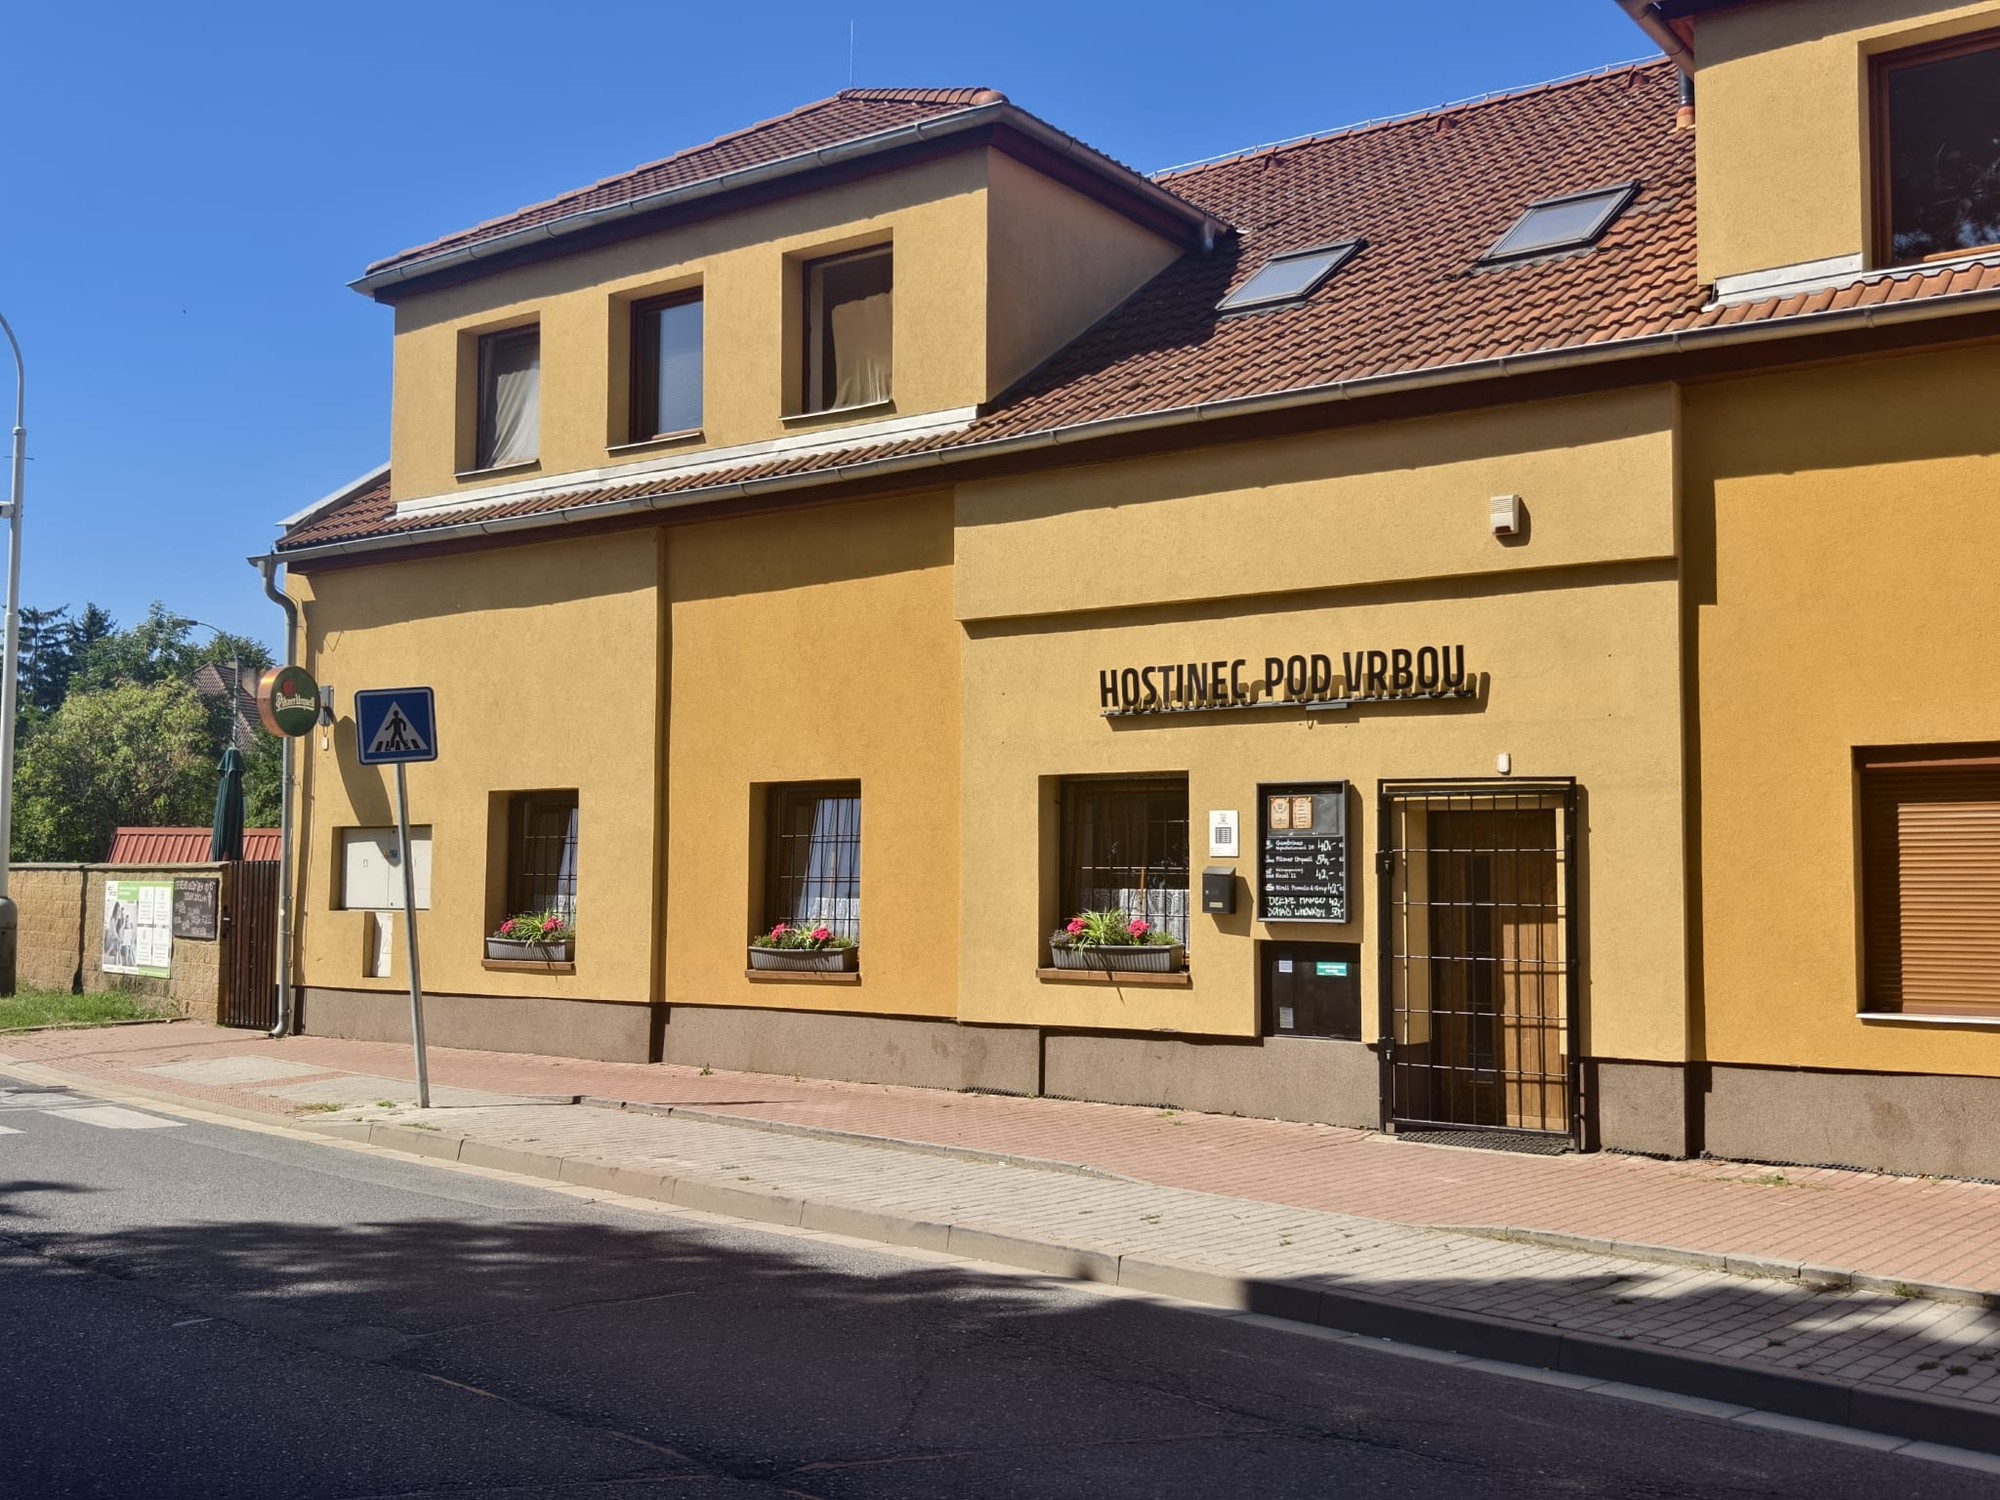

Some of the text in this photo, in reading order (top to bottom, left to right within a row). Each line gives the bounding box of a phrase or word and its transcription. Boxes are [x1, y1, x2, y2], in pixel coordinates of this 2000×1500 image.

[1099, 644, 1465, 708] HOSTINEC POD VRBOU
